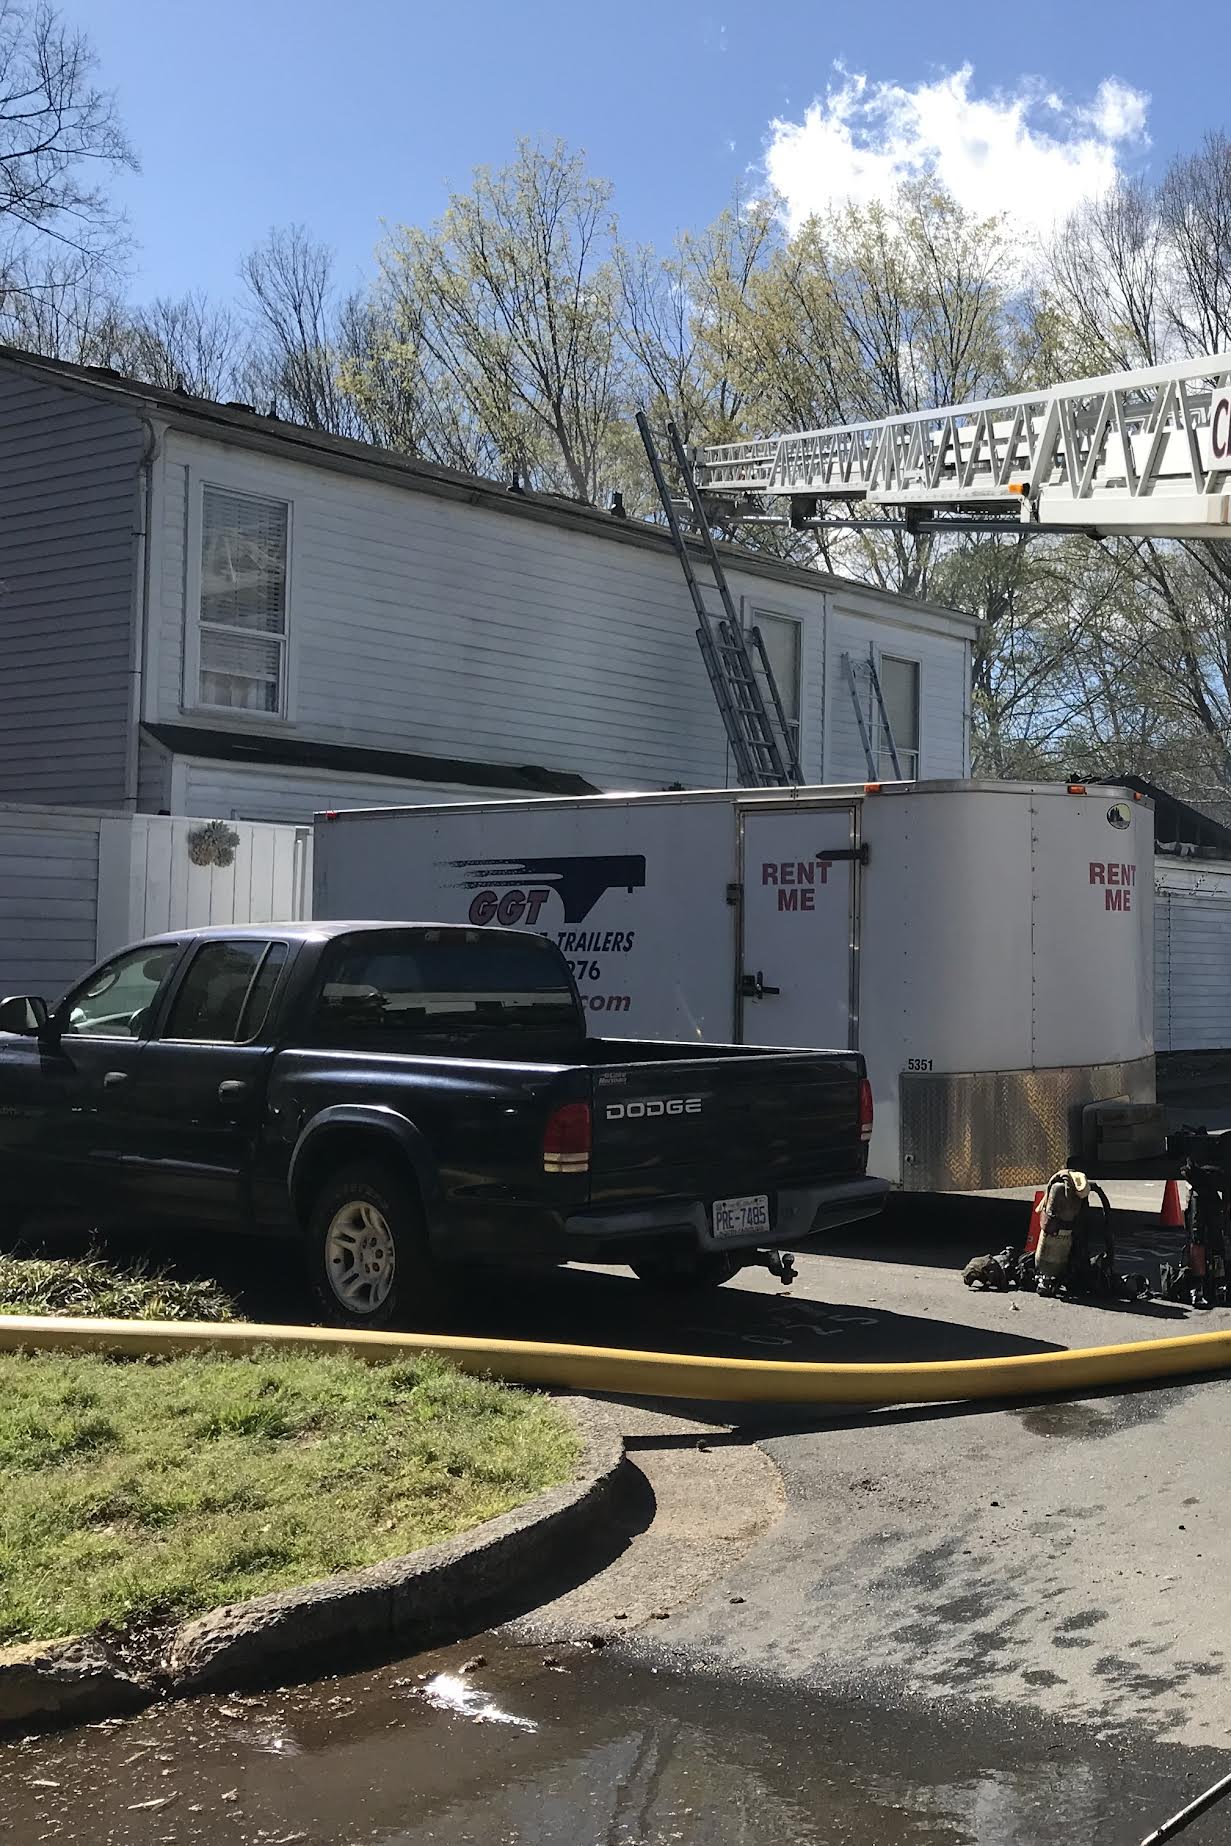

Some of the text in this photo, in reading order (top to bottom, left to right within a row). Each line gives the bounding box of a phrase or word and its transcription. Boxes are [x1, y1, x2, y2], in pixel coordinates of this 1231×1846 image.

[762, 861, 832, 886] RENT
[1089, 862, 1136, 886] RENT
[469, 890, 550, 926] GGT
[777, 888, 816, 911] ME
[1105, 888, 1131, 911] ME
[557, 932, 635, 952] TRAILERS
[908, 1058, 934, 1072] 5351
[606, 1098, 701, 1120] DODGE
